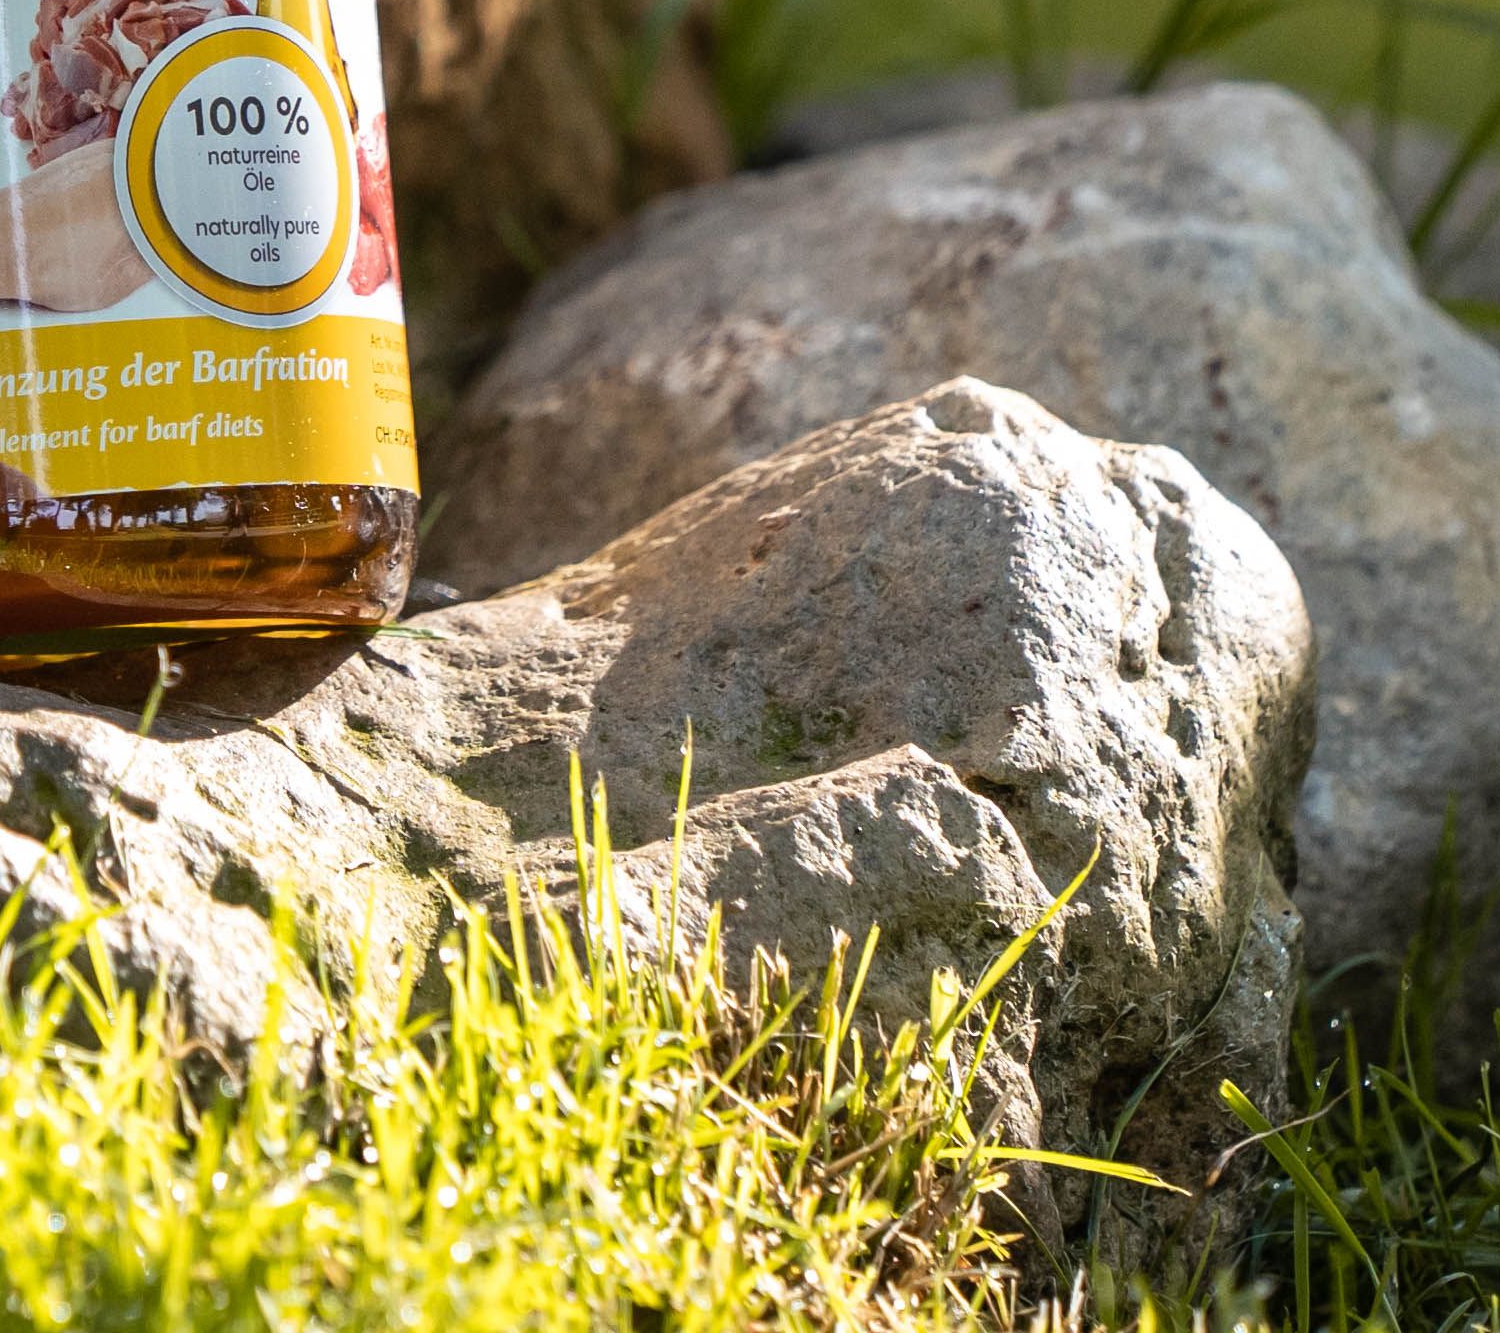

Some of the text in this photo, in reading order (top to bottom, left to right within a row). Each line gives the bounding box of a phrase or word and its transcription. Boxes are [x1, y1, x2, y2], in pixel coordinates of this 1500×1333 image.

[187, 95, 310, 136] 100 %
[207, 145, 301, 166] naturreine
[242, 167, 275, 192] Öle
[195, 214, 320, 240] naturally pure
[250, 241, 281, 263] oils
[120, 351, 178, 388] der
[192, 346, 349, 392] Barfration
[98, 415, 136, 451] for
[146, 412, 203, 445] barf
[207, 411, 264, 439] diets
